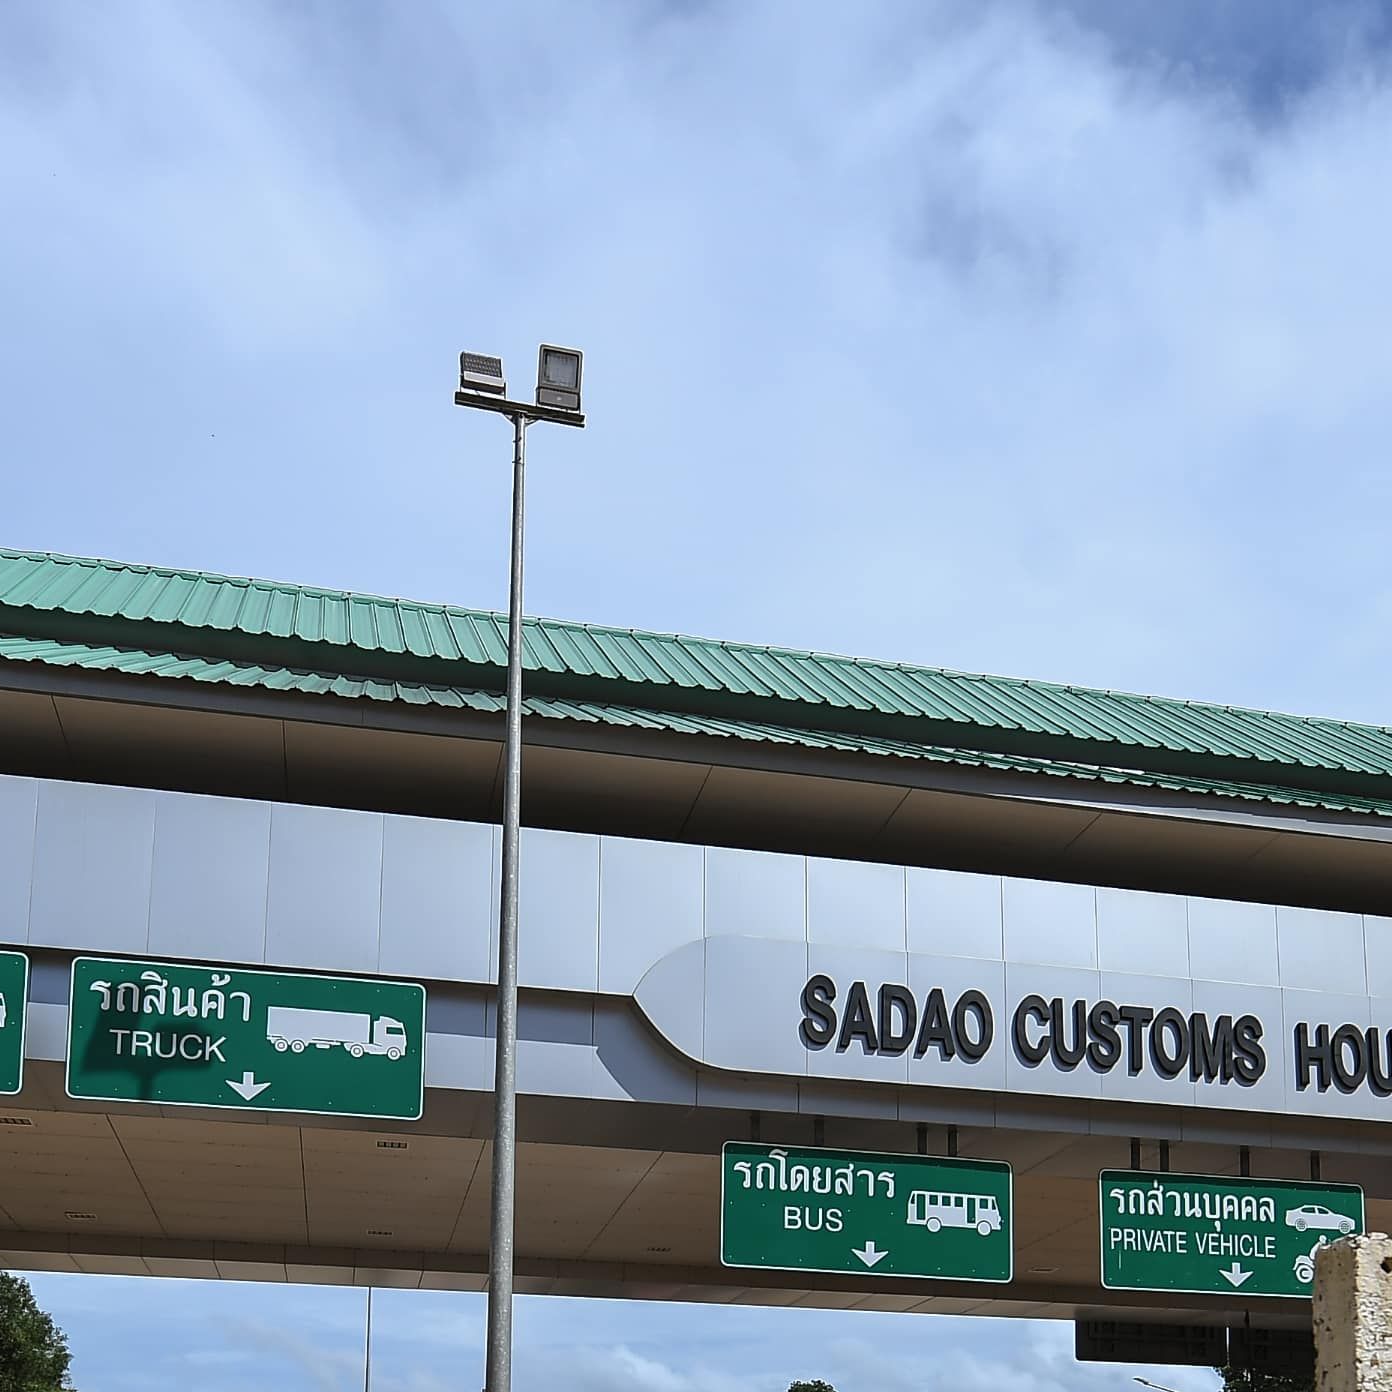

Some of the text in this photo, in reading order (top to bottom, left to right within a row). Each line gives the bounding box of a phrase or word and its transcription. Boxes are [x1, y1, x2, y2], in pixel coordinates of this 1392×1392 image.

[89, 970, 251, 1022] รถสินค้า
[109, 1029, 227, 1063] TRUCK
[798, 973, 994, 1065] SADAO
[1011, 993, 1267, 1087] CUSTOMS
[733, 1148, 895, 1199] รถโดยสาร
[784, 1206, 844, 1232] BUS
[1109, 1179, 1275, 1233] รถส่วนบุคคล
[1110, 1227, 1277, 1259] PRIVATE VEHICLE
